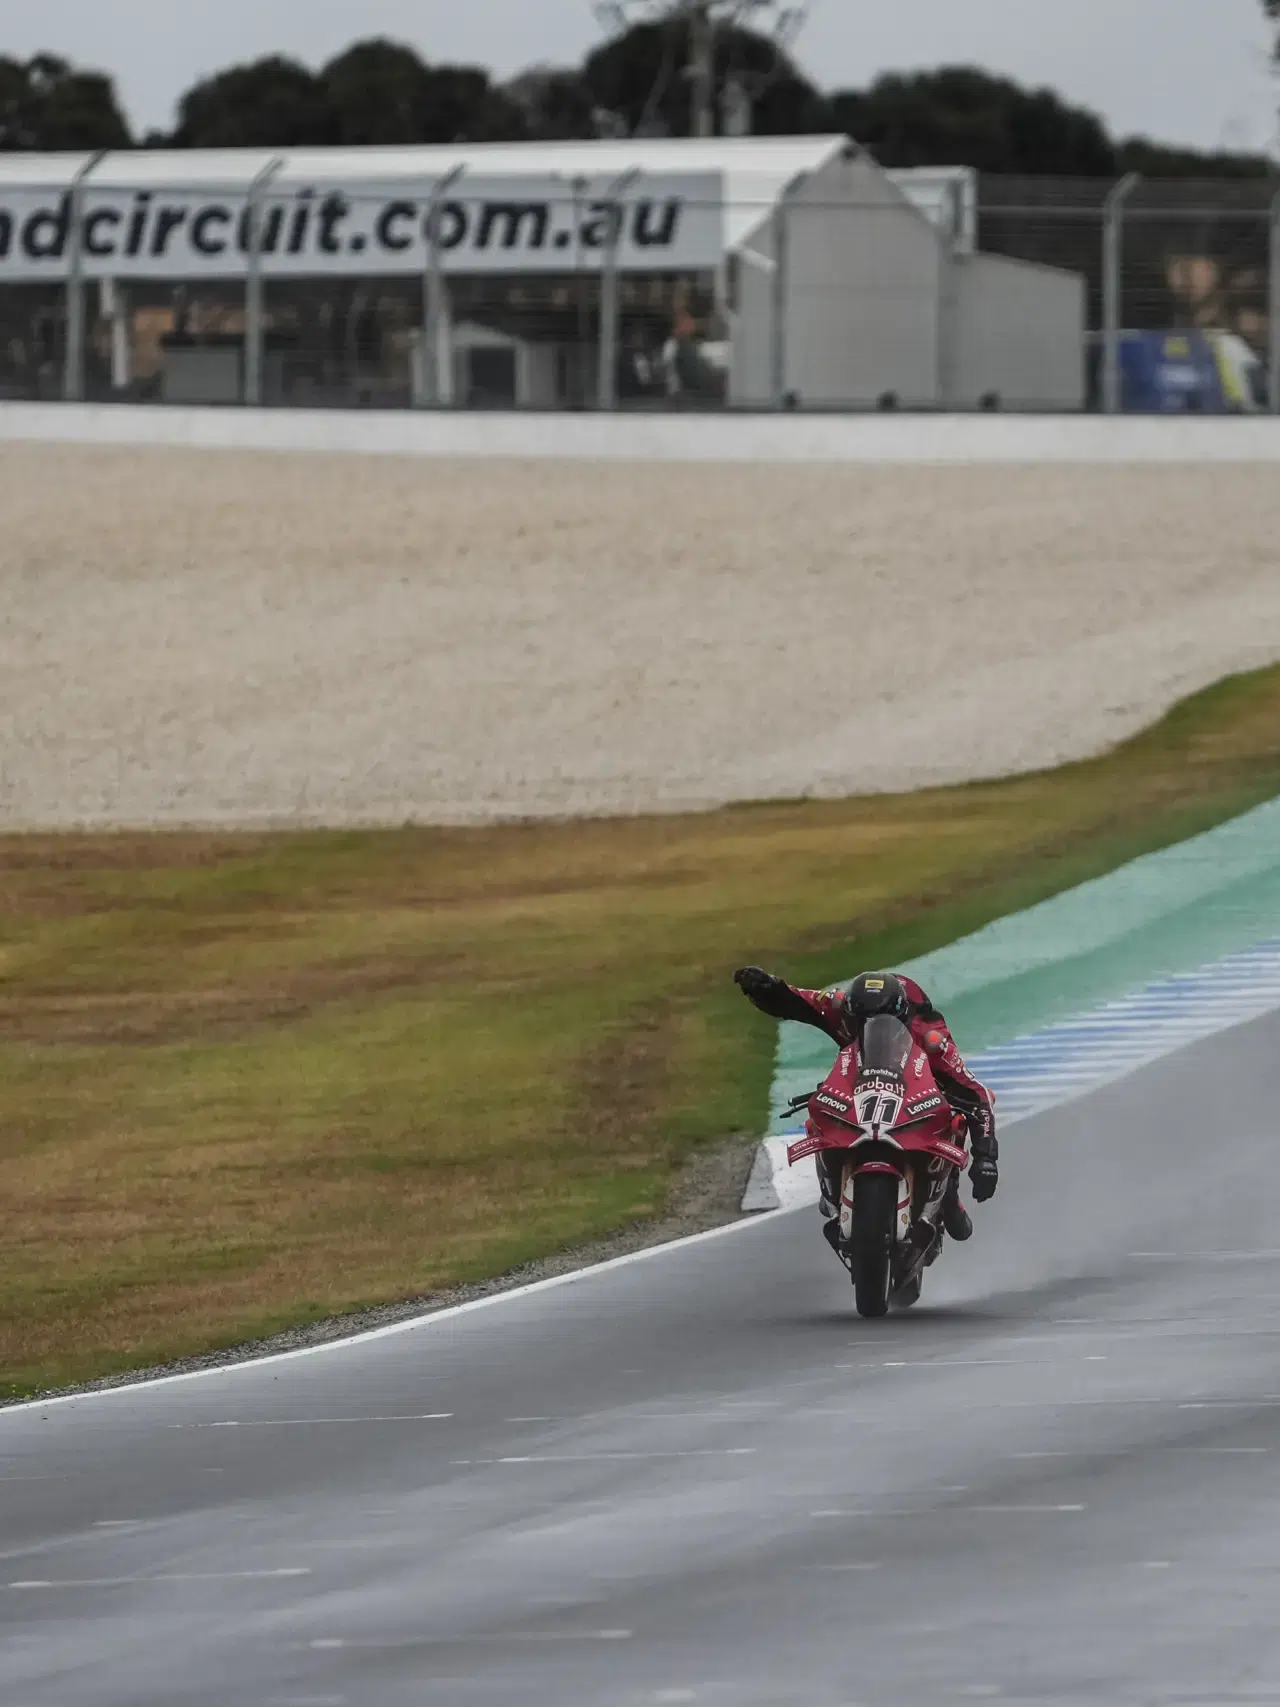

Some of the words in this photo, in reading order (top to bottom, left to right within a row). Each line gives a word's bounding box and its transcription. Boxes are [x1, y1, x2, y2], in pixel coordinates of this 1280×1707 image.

[0, 189, 683, 258] dcircuit.com.au
[853, 1076, 905, 1098] aruba.it
[816, 1092, 848, 1112] Lenovo
[859, 1093, 899, 1126] 11
[907, 1097, 941, 1115] Lenovo
